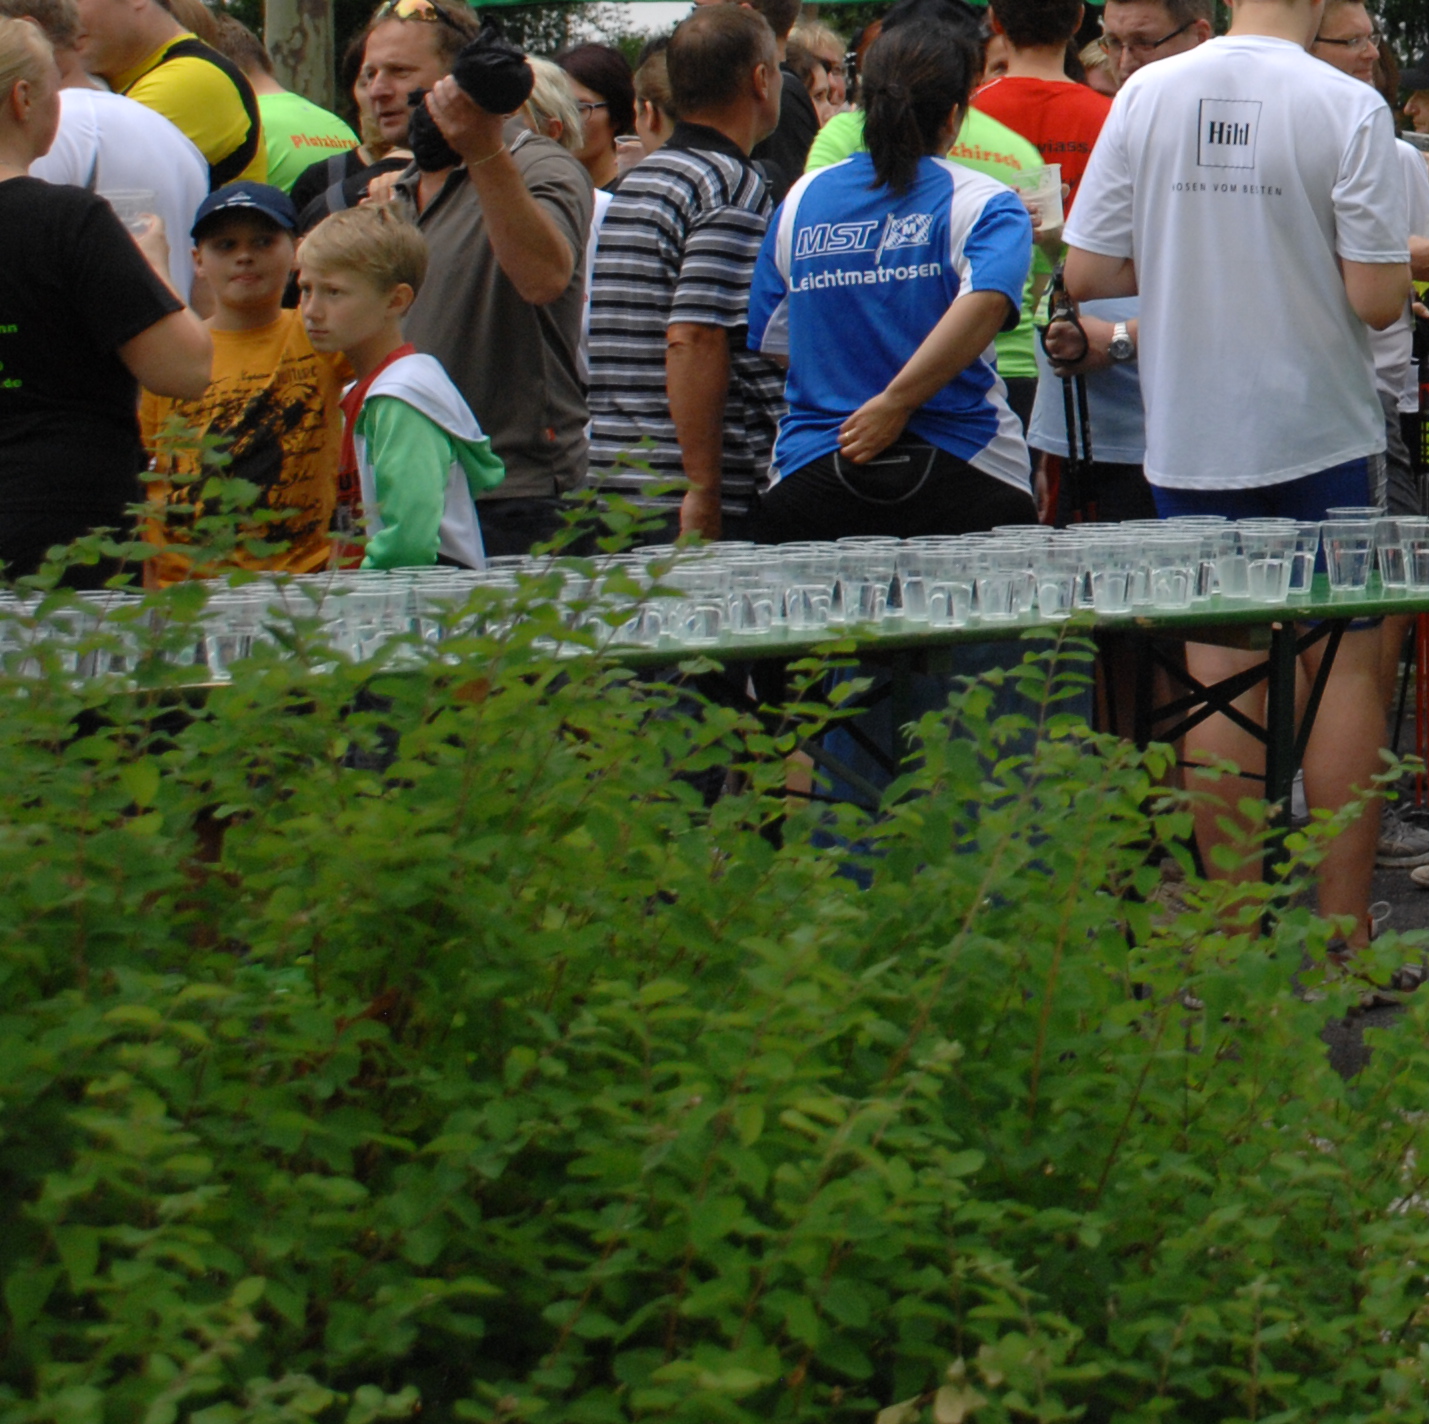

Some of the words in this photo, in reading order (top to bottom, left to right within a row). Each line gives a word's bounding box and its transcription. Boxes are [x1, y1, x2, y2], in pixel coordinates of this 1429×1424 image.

[1212, 184, 1237, 193] VOM
[795, 220, 879, 256] MST
[789, 262, 942, 293] Leichtmatrosen
